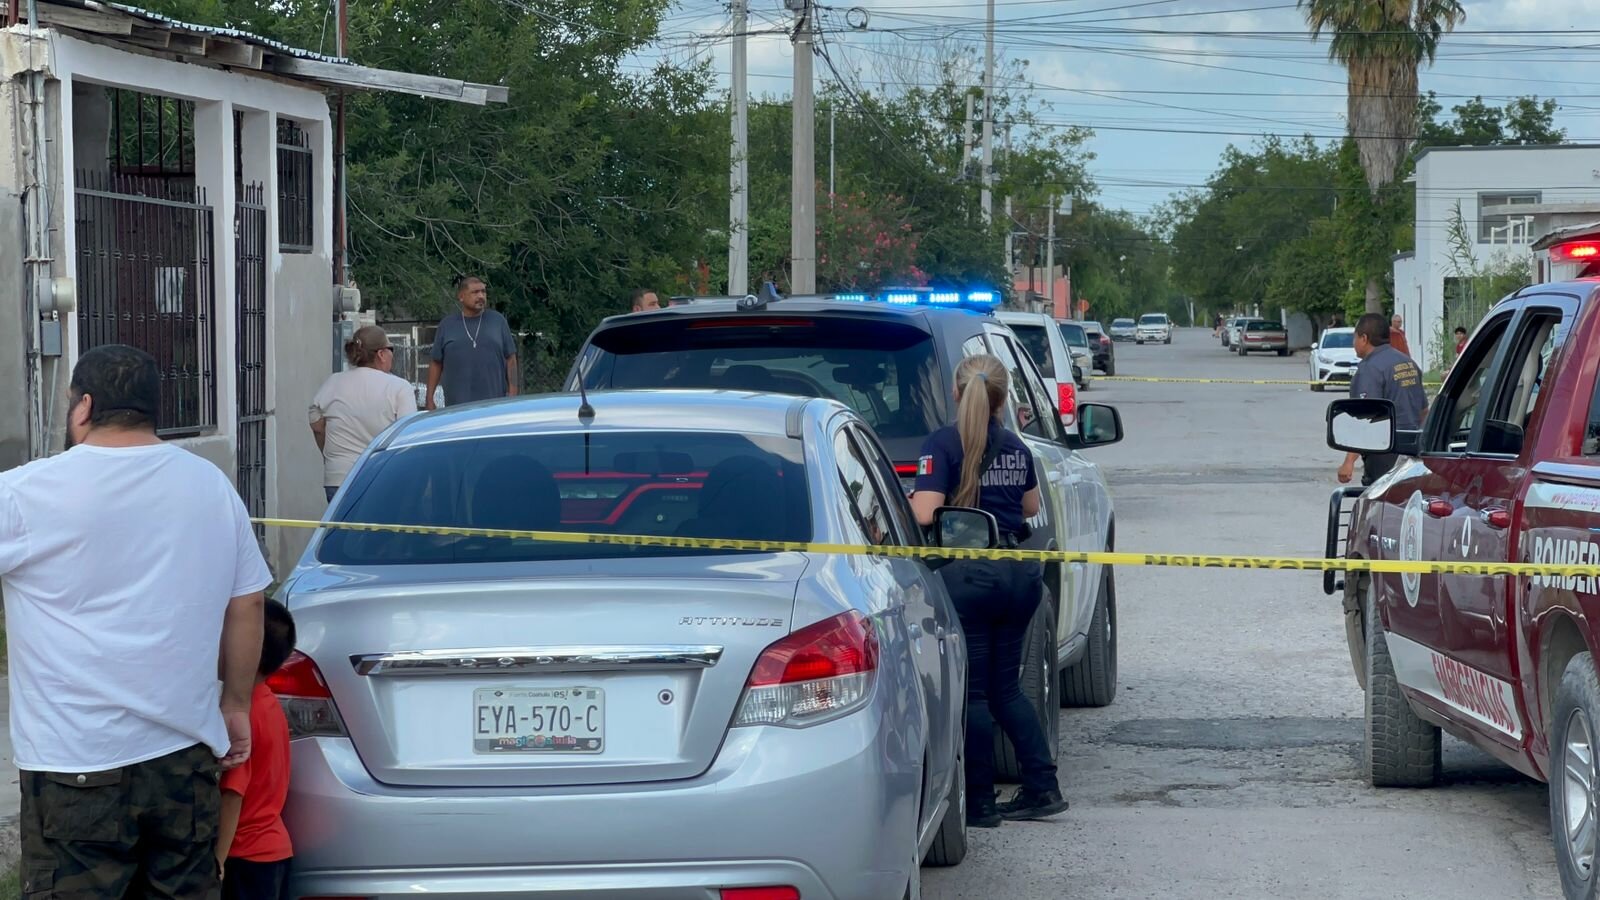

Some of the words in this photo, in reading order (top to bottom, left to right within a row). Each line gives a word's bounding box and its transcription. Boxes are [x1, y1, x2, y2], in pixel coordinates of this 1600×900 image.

[679, 616, 783, 627] ATTITUDE
[1431, 652, 1515, 734] EMERGENCIAS
[478, 705, 598, 733] EYA-570-C
